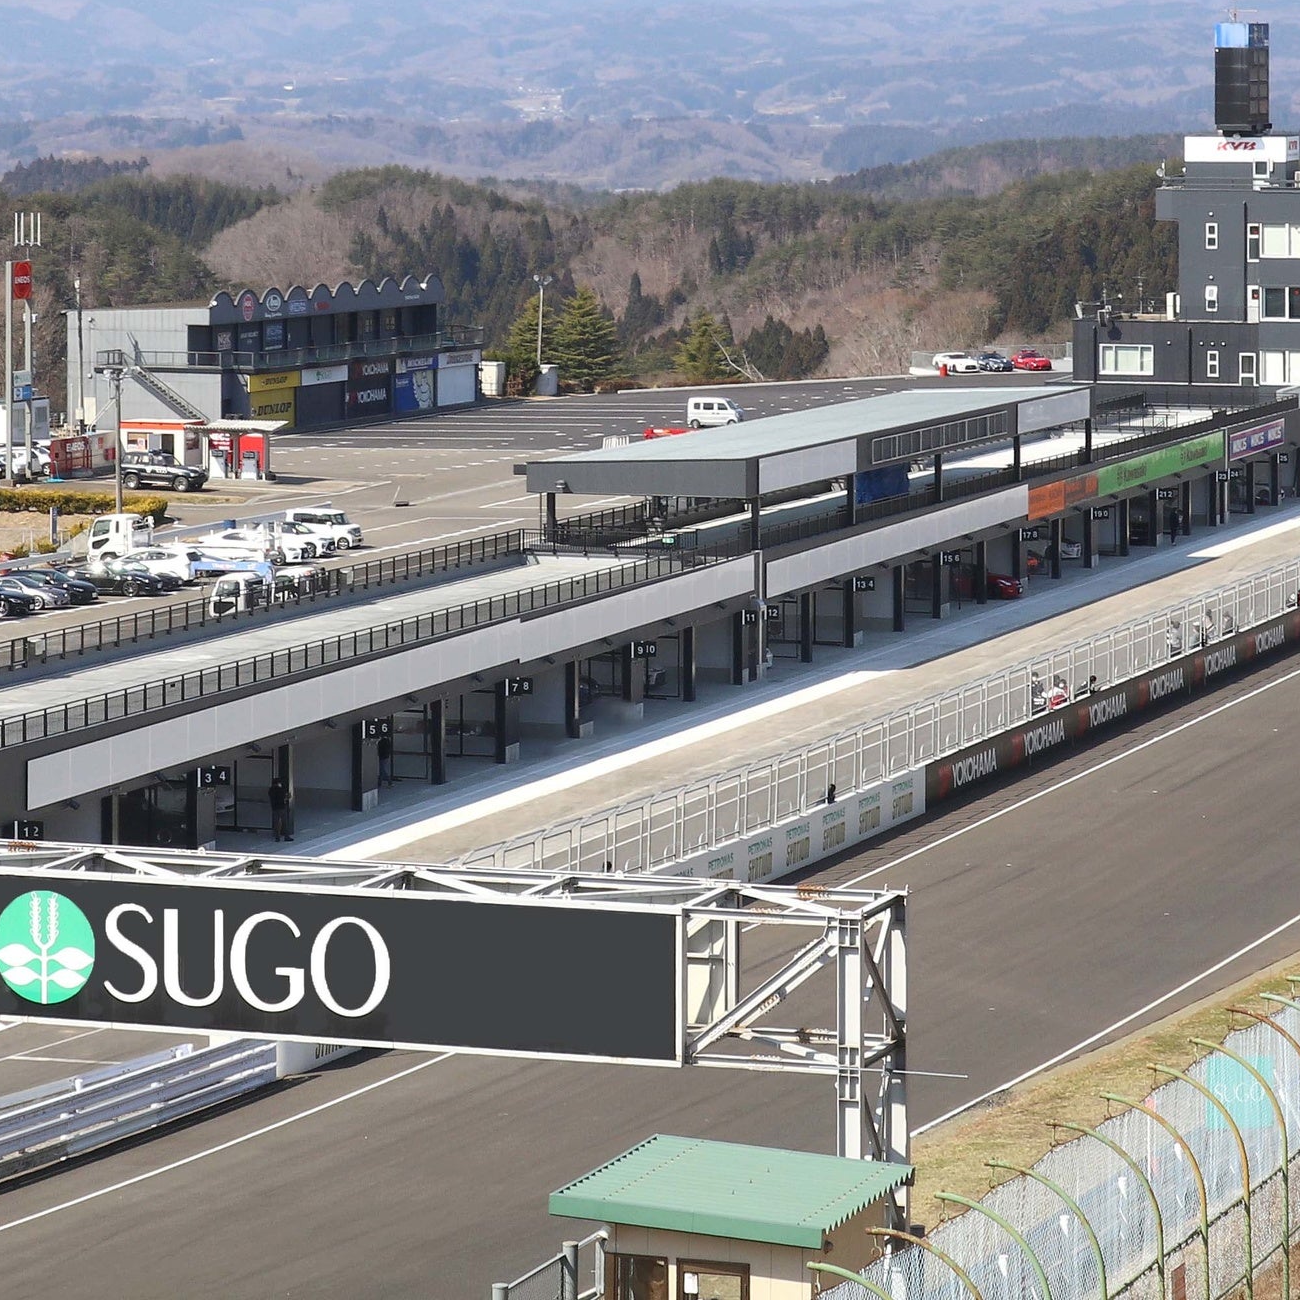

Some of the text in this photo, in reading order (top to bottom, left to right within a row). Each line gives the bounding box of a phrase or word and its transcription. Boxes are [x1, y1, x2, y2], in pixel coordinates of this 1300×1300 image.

[14, 276, 31, 285] ENEOS
[357, 388, 387, 403] YOKOHAMA
[257, 402, 292, 416] DUNLOP
[746, 613, 755, 621] 11
[768, 609, 777, 617] 12
[1255, 624, 1285, 654] YOKOHAMA
[1204, 645, 1236, 676] YOKOHAMA
[511, 683, 518, 692] 7
[523, 682, 529, 690] 8
[1149, 668, 1184, 700] YOKOHAMA
[1089, 693, 1127, 727] YOKOHAMA
[369, 725, 375, 734] 5
[381, 724, 388, 732] 6
[1023, 719, 1065, 756] YOKOHAMA
[219, 771, 226, 780] 4
[952, 748, 997, 788] YOKOHAMA
[205, 773, 212, 783] 3
[892, 778, 913, 795] PETRONAS
[859, 792, 880, 809] PETRONAS
[822, 808, 845, 826] PETRONAS
[23, 827, 29, 837] 1
[33, 826, 39, 836] 2
[786, 822, 810, 840] PETRONAS
[748, 836, 772, 855] PETRONAS
[708, 853, 733, 871] PETRONAS
[103, 902, 391, 1018] SUGO
